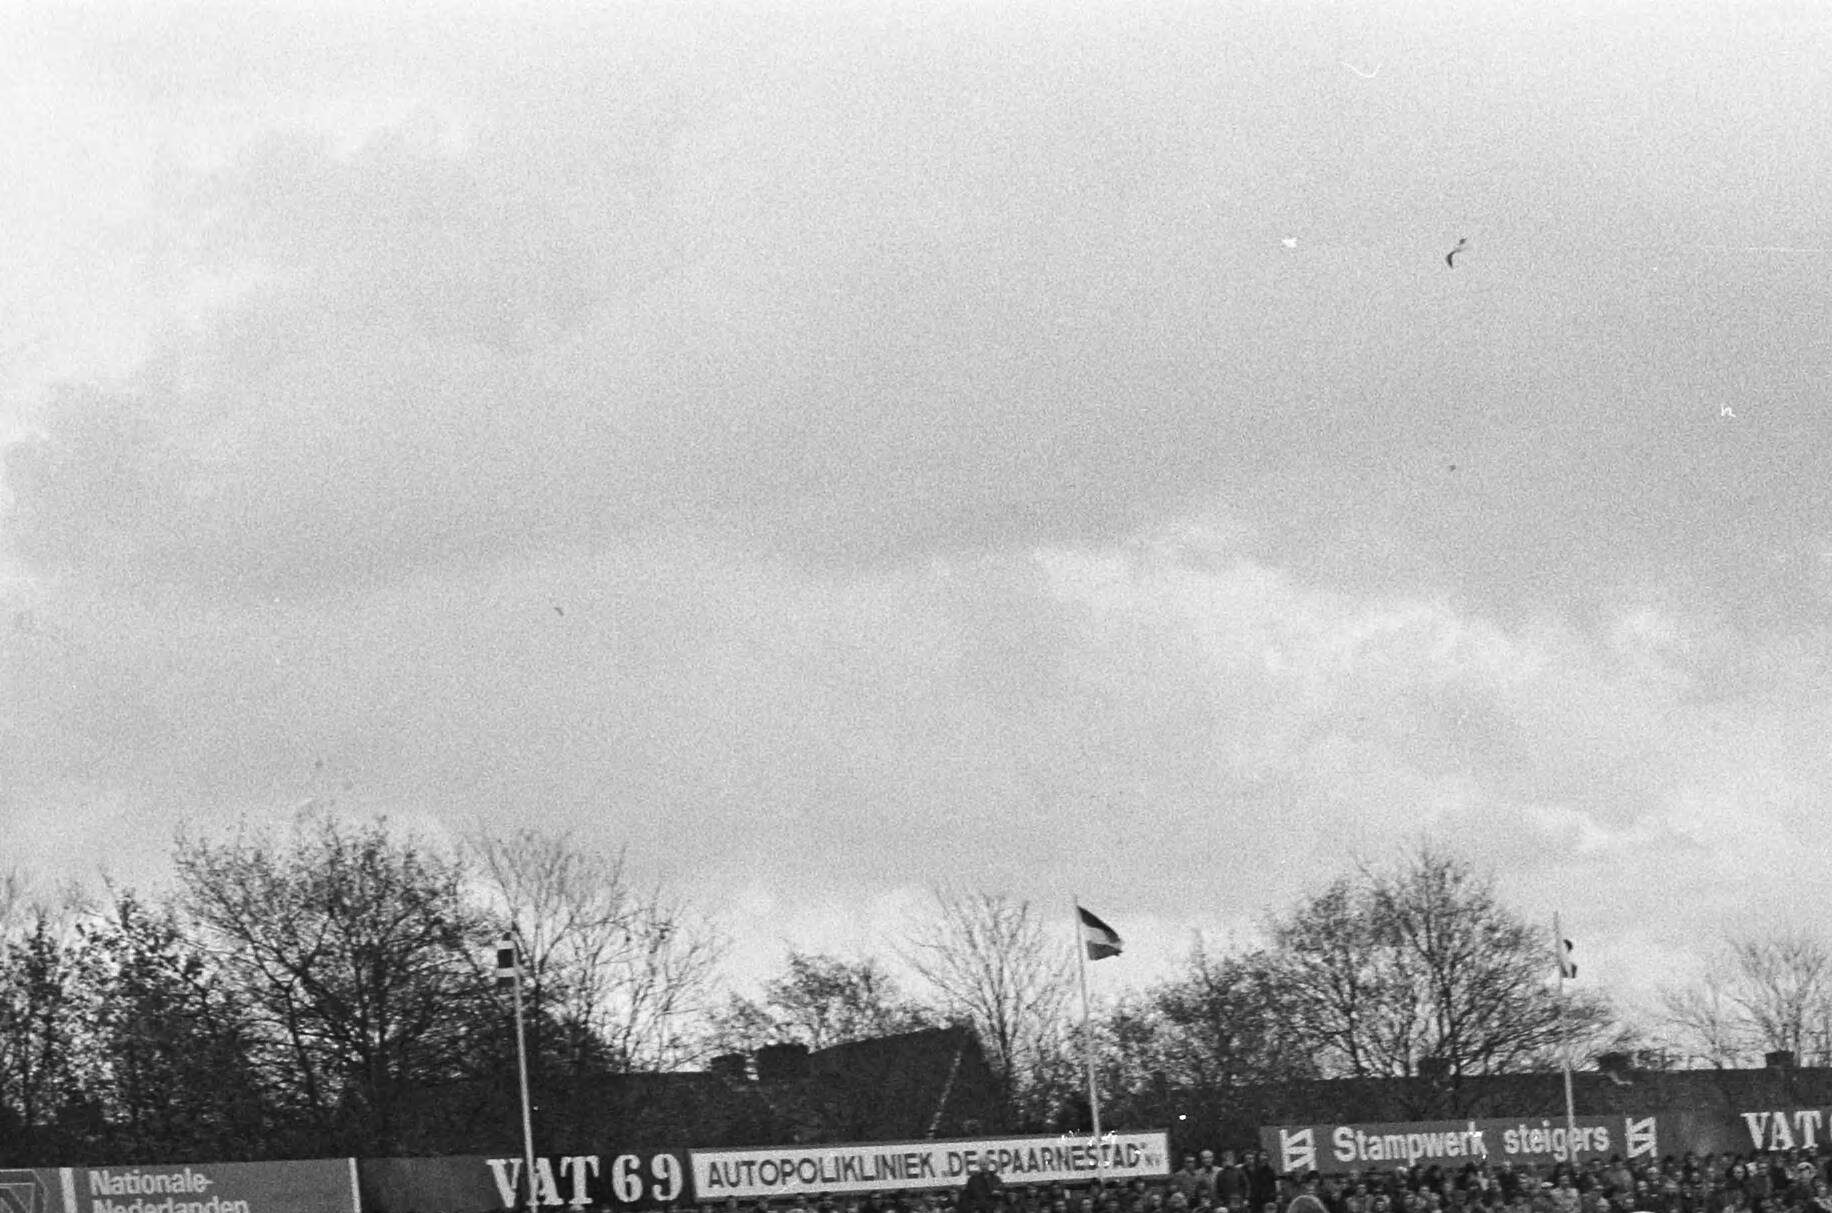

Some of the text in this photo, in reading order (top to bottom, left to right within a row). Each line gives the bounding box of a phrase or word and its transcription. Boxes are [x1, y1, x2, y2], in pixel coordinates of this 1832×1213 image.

[1333, 1120, 1610, 1167] Stampwerk steigers
[1740, 1110, 1823, 1152] VAT
[90, 1167, 214, 1196] Nationale-
[486, 1153, 684, 1208] VAT 69
[707, 1151, 936, 1189] AUTOPOLIKLINIEK
